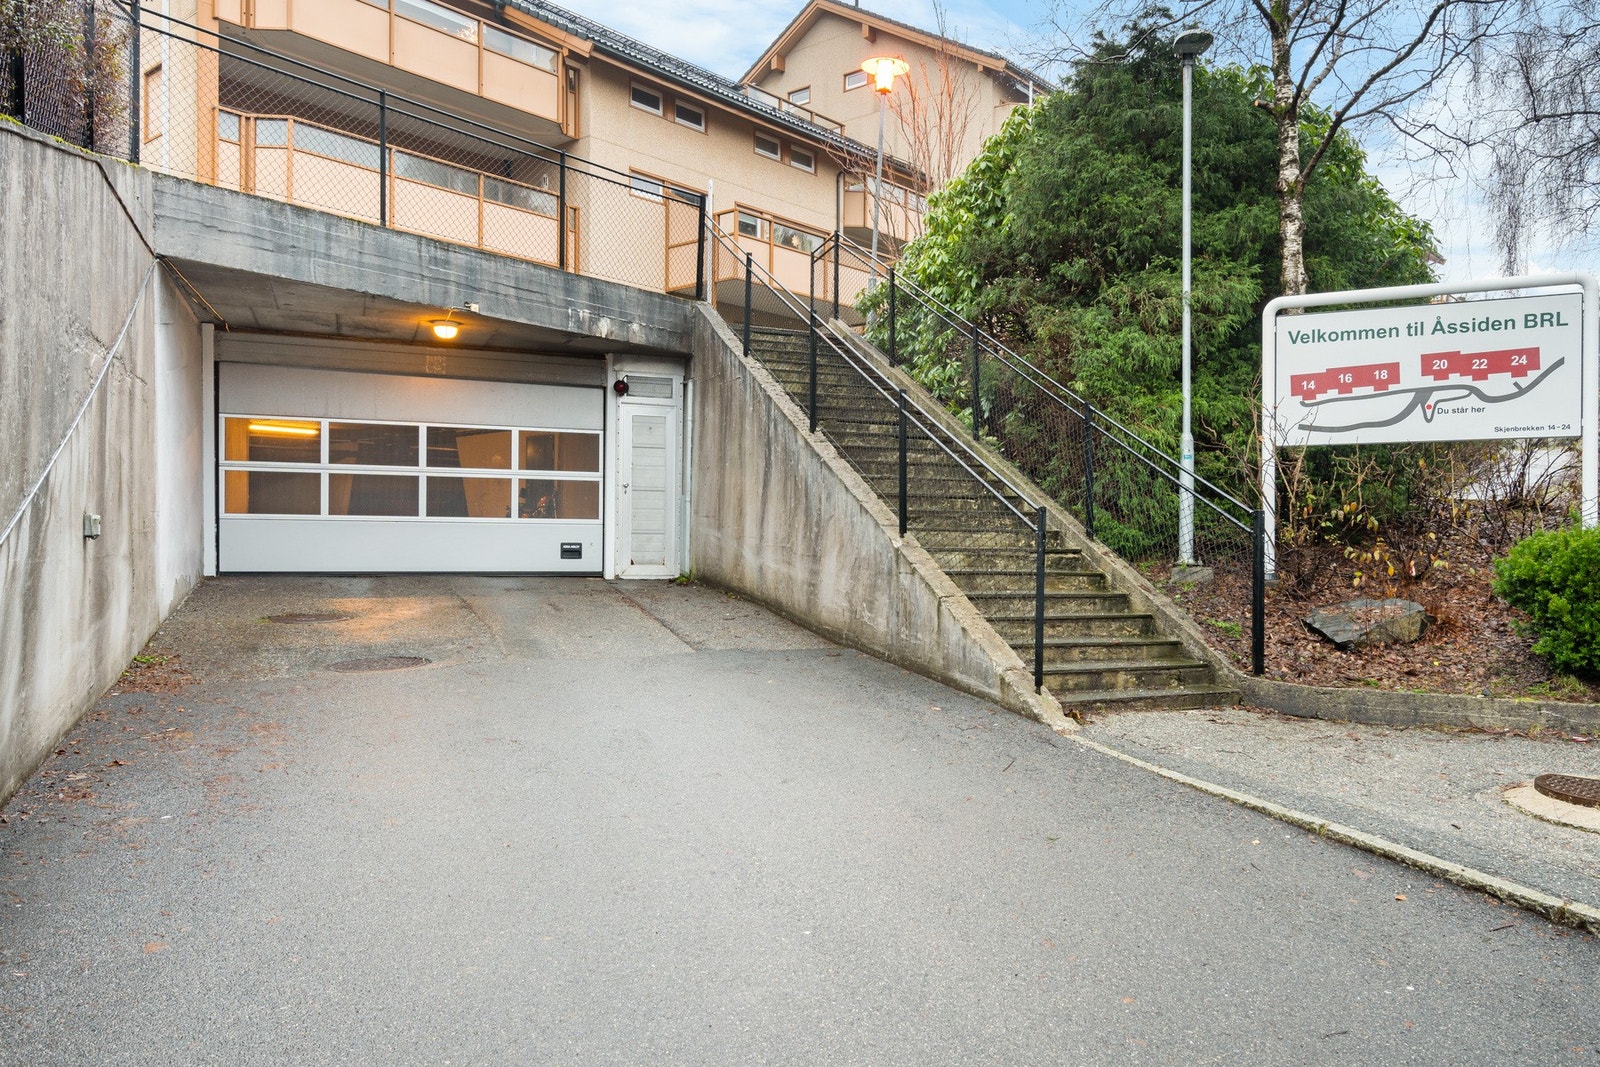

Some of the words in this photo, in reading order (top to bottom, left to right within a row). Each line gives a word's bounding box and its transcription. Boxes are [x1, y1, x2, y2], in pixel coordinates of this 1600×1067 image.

[1288, 325, 1400, 345] Velkommen
[1406, 321, 1424, 337] til
[1431, 315, 1516, 335] Åssiden
[1524, 311, 1569, 329] BRL
[1432, 359, 1448, 370] 20
[1471, 358, 1488, 369] 22
[1510, 355, 1528, 366] 24
[1301, 380, 1316, 390] 14
[1338, 373, 1353, 384] 16
[1373, 369, 1388, 380] 18
[1437, 407, 1449, 415] Du
[1451, 406, 1469, 414] står
[1471, 405, 1486, 413] her
[1494, 424, 1545, 433] Skjenbrekken
